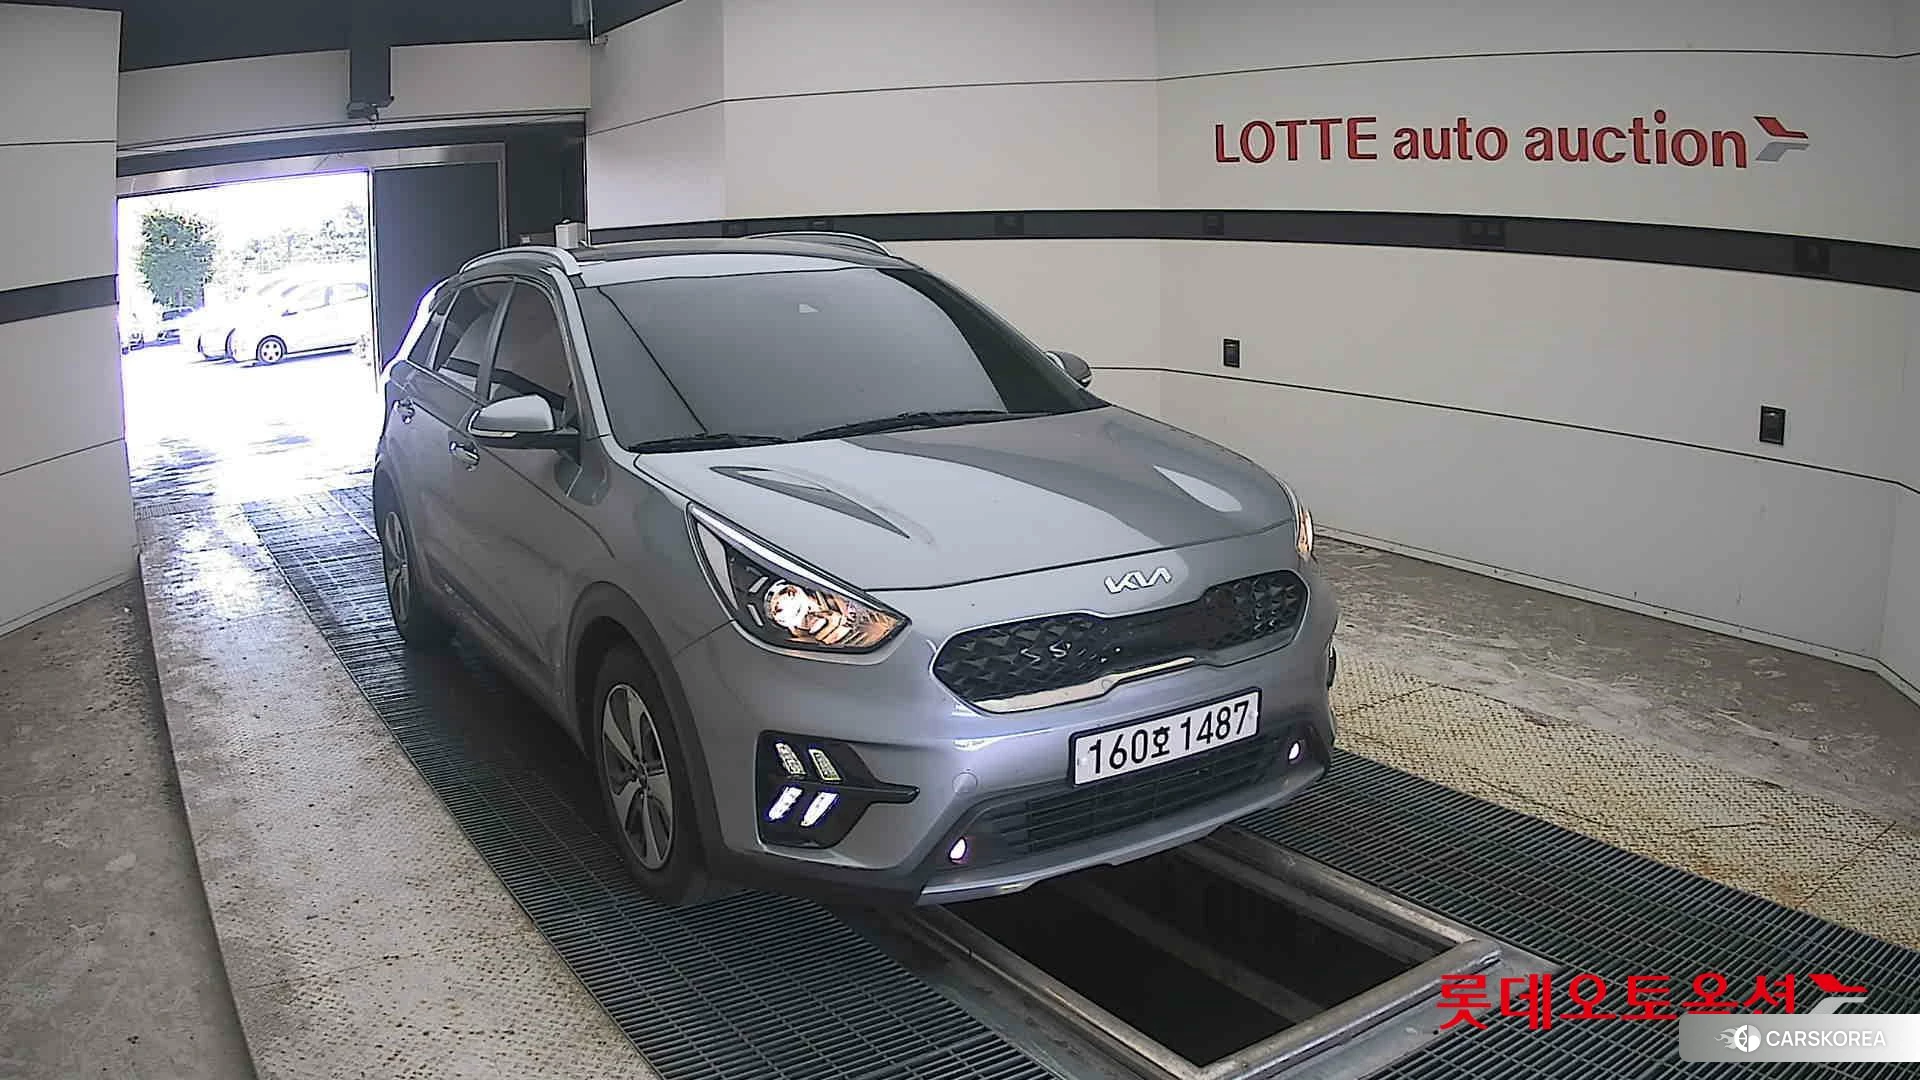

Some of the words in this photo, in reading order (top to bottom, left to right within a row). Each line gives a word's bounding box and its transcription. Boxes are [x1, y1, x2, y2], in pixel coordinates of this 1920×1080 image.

[1215, 116, 1377, 163] LOTTE
[1393, 116, 1508, 161] auto
[1524, 109, 1747, 168] auction
[1104, 567, 1172, 594] KIA
[1088, 726, 1170, 774] 160호
[1181, 700, 1249, 750] 1487
